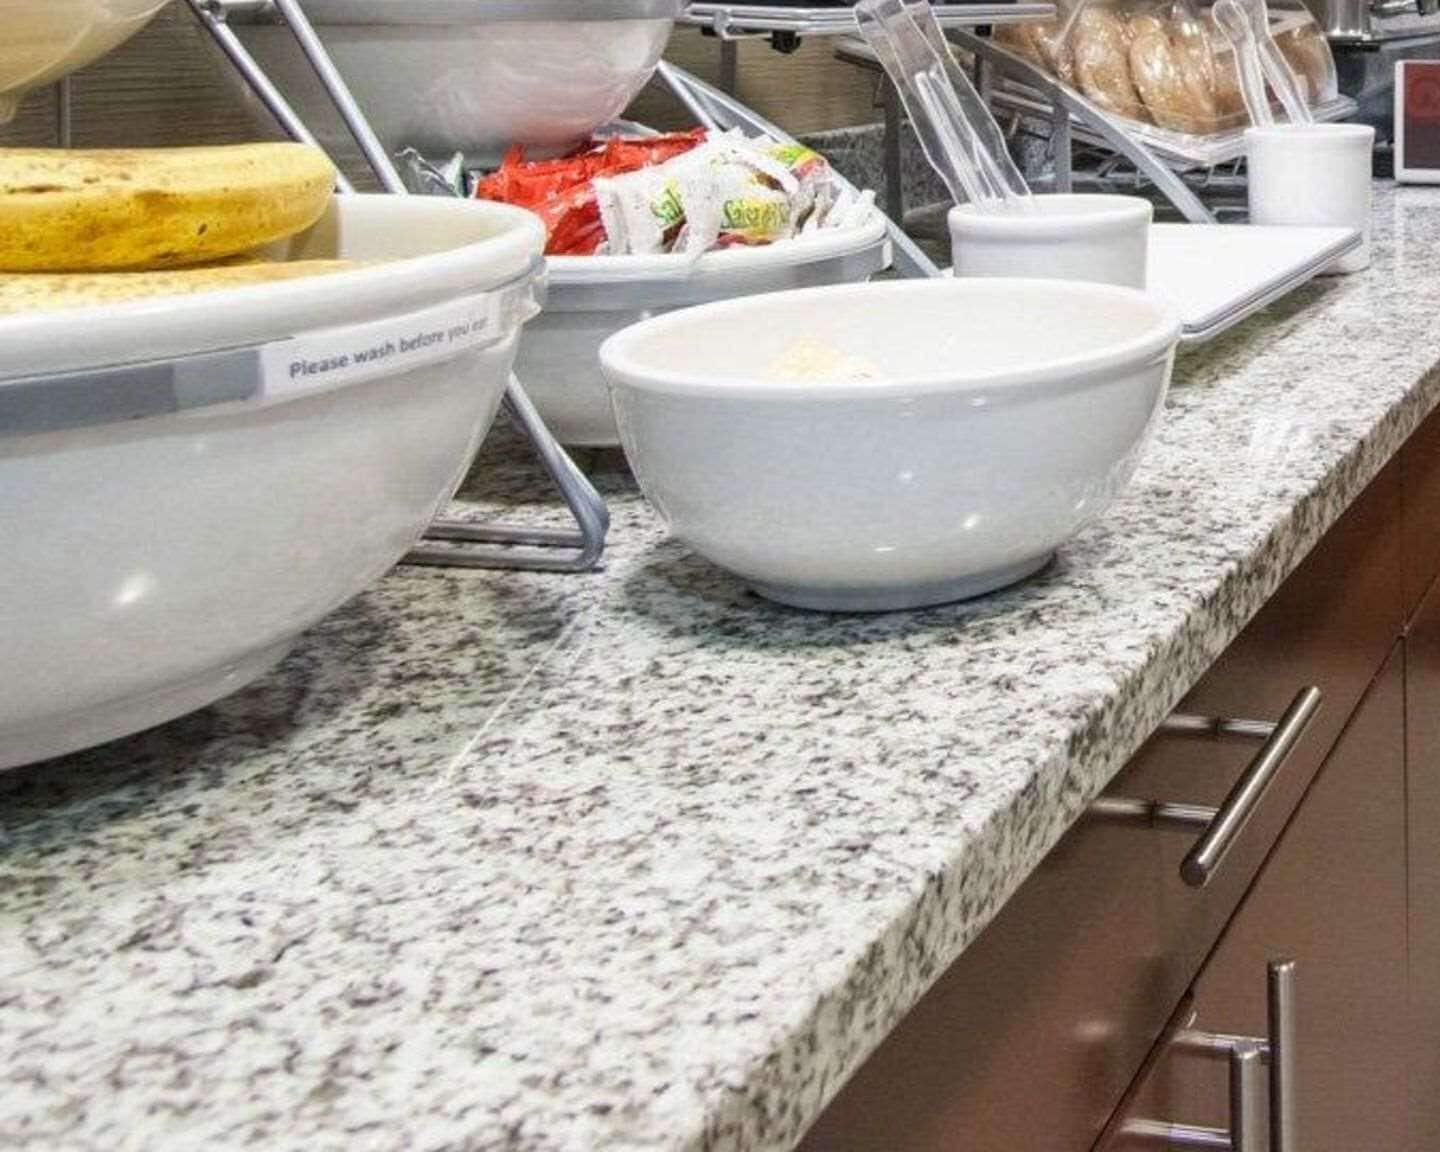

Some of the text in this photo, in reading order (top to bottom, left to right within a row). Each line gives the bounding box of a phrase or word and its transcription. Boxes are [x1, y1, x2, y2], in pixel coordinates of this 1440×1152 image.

[289, 353, 349, 378] Please
[353, 339, 396, 364] wash
[400, 332, 445, 353] before
[448, 323, 470, 344] you
